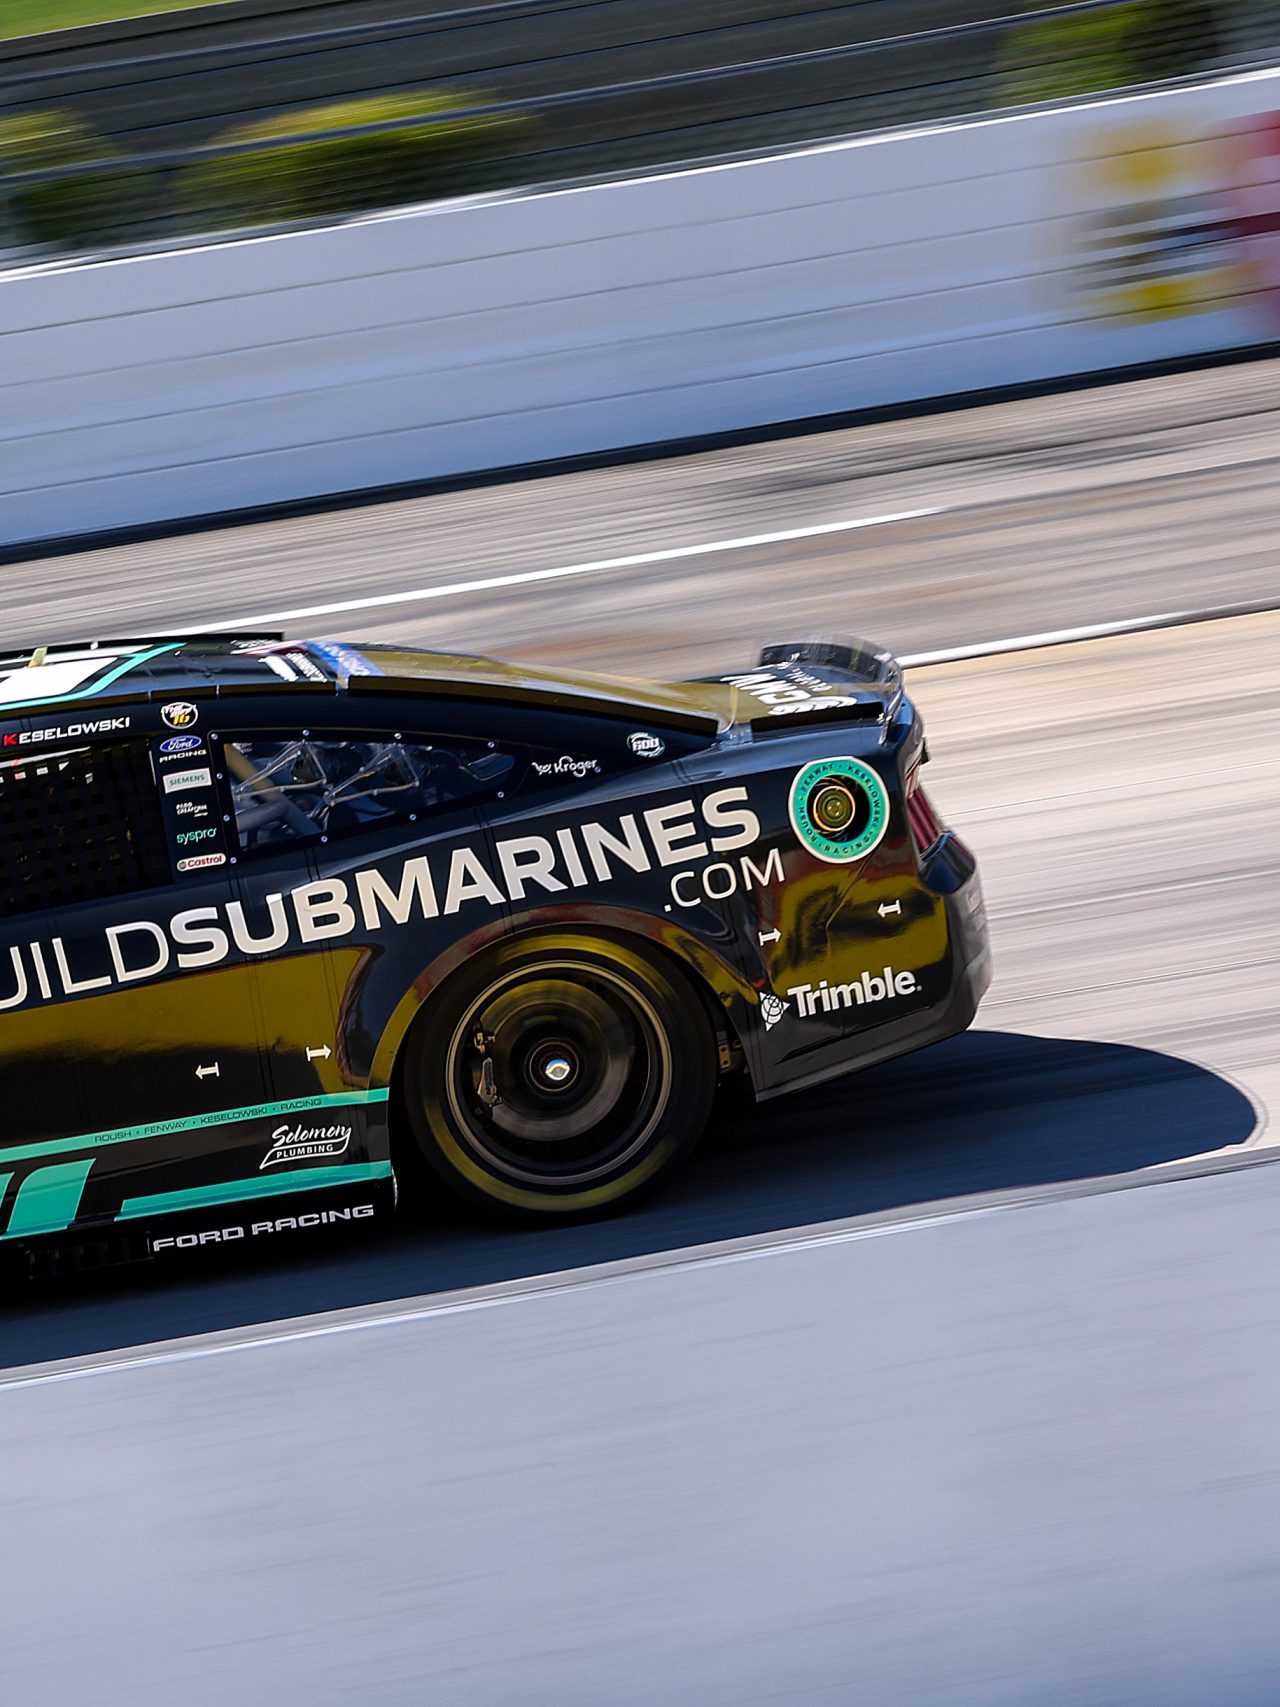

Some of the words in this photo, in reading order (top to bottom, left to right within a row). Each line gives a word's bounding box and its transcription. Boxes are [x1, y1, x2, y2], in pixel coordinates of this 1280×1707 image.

[2, 717, 131, 748] KESELOWSKI
[168, 737, 194, 751] Ford
[159, 749, 207, 763] RACING
[554, 756, 597, 778] Kroger
[169, 774, 206, 787] SIEMENS
[801, 763, 833, 791] FENWAY
[848, 764, 880, 829] KESELOWSKI
[176, 828, 217, 845] syspro
[798, 807, 817, 842] ROUSH
[824, 834, 871, 854] RACING
[187, 855, 222, 868] Castrol
[664, 848, 785, 912] .COM
[786, 966, 918, 1018] Trimble
[94, 1130, 131, 1143] ROUSH
[144, 1120, 187, 1135] FENWAY
[200, 1106, 267, 1125] KESELOWSKI
[280, 1098, 322, 1111] RACING
[277, 1143, 334, 1159] PLUMBING
[153, 1226, 244, 1252] FORD
[251, 1204, 375, 1235] RACING
